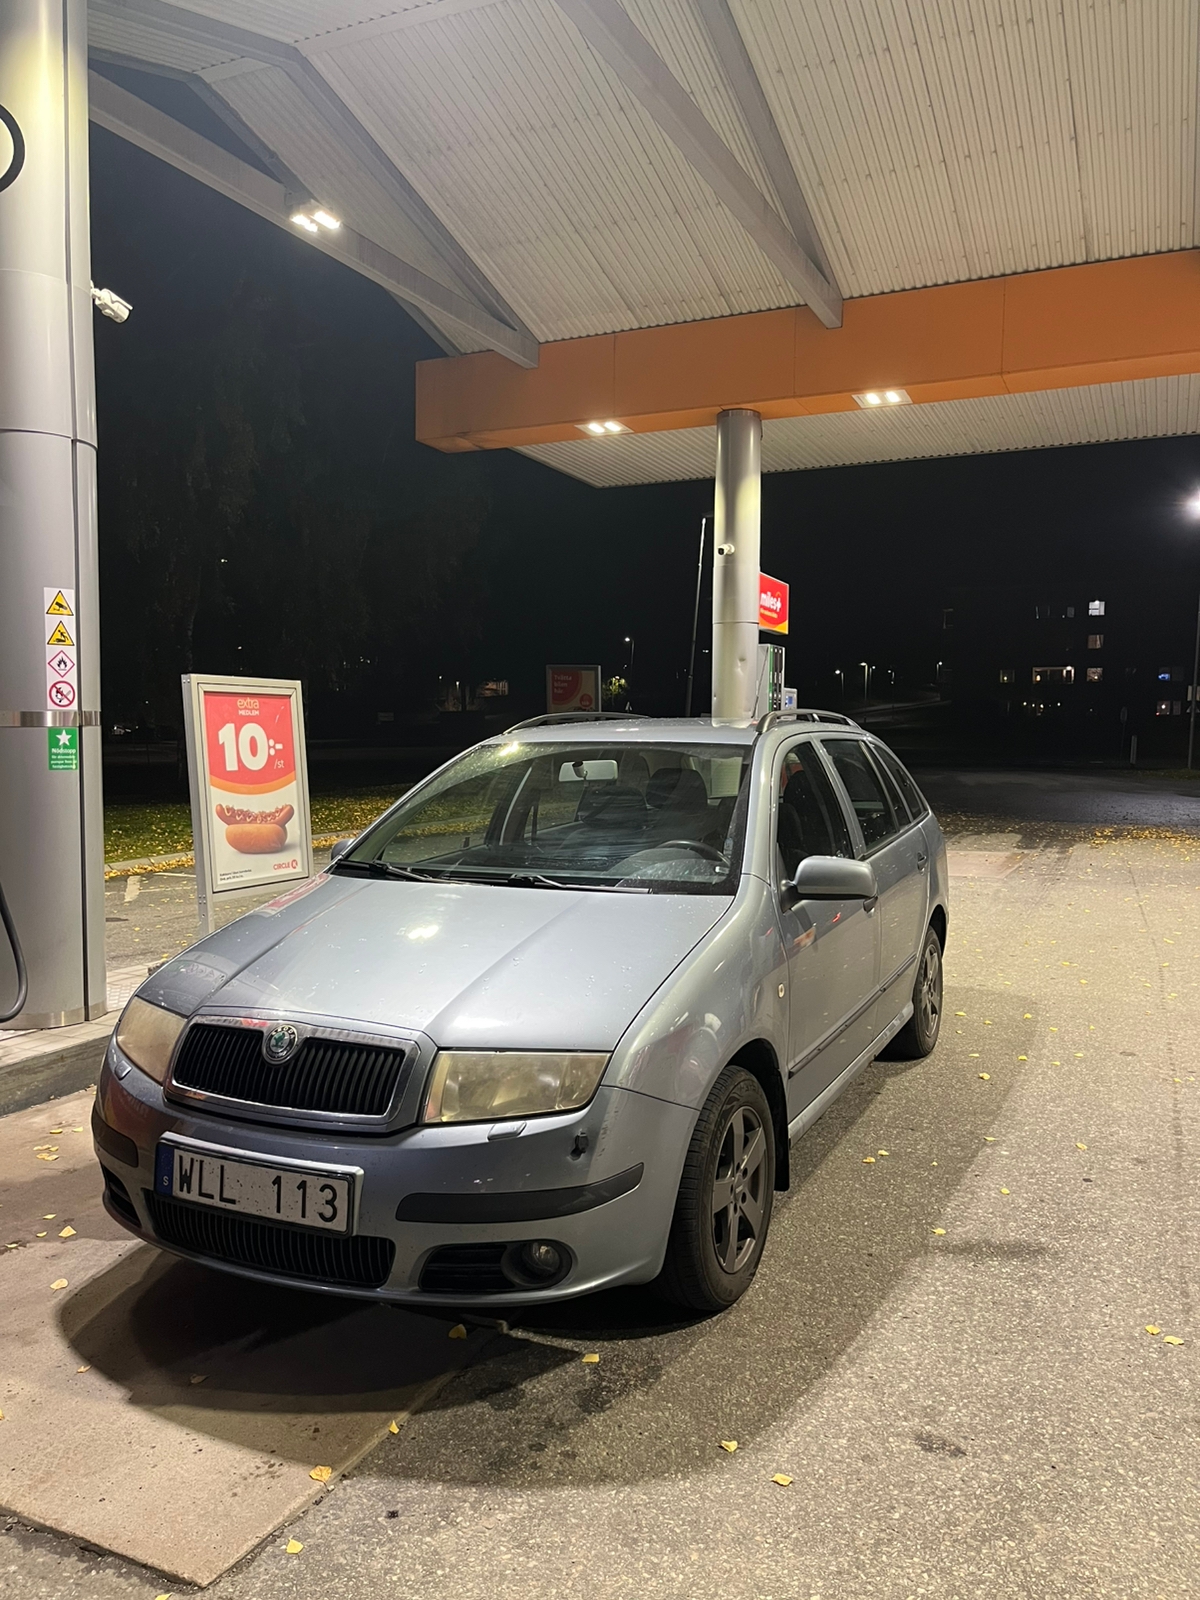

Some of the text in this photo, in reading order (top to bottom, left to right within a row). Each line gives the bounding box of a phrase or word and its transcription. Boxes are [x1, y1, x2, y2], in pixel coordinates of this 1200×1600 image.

[237, 697, 260, 709] extra
[272, 862, 291, 871] CIRCLE
[163, 1175, 169, 1186] S
[178, 1154, 338, 1223] WLL 113
